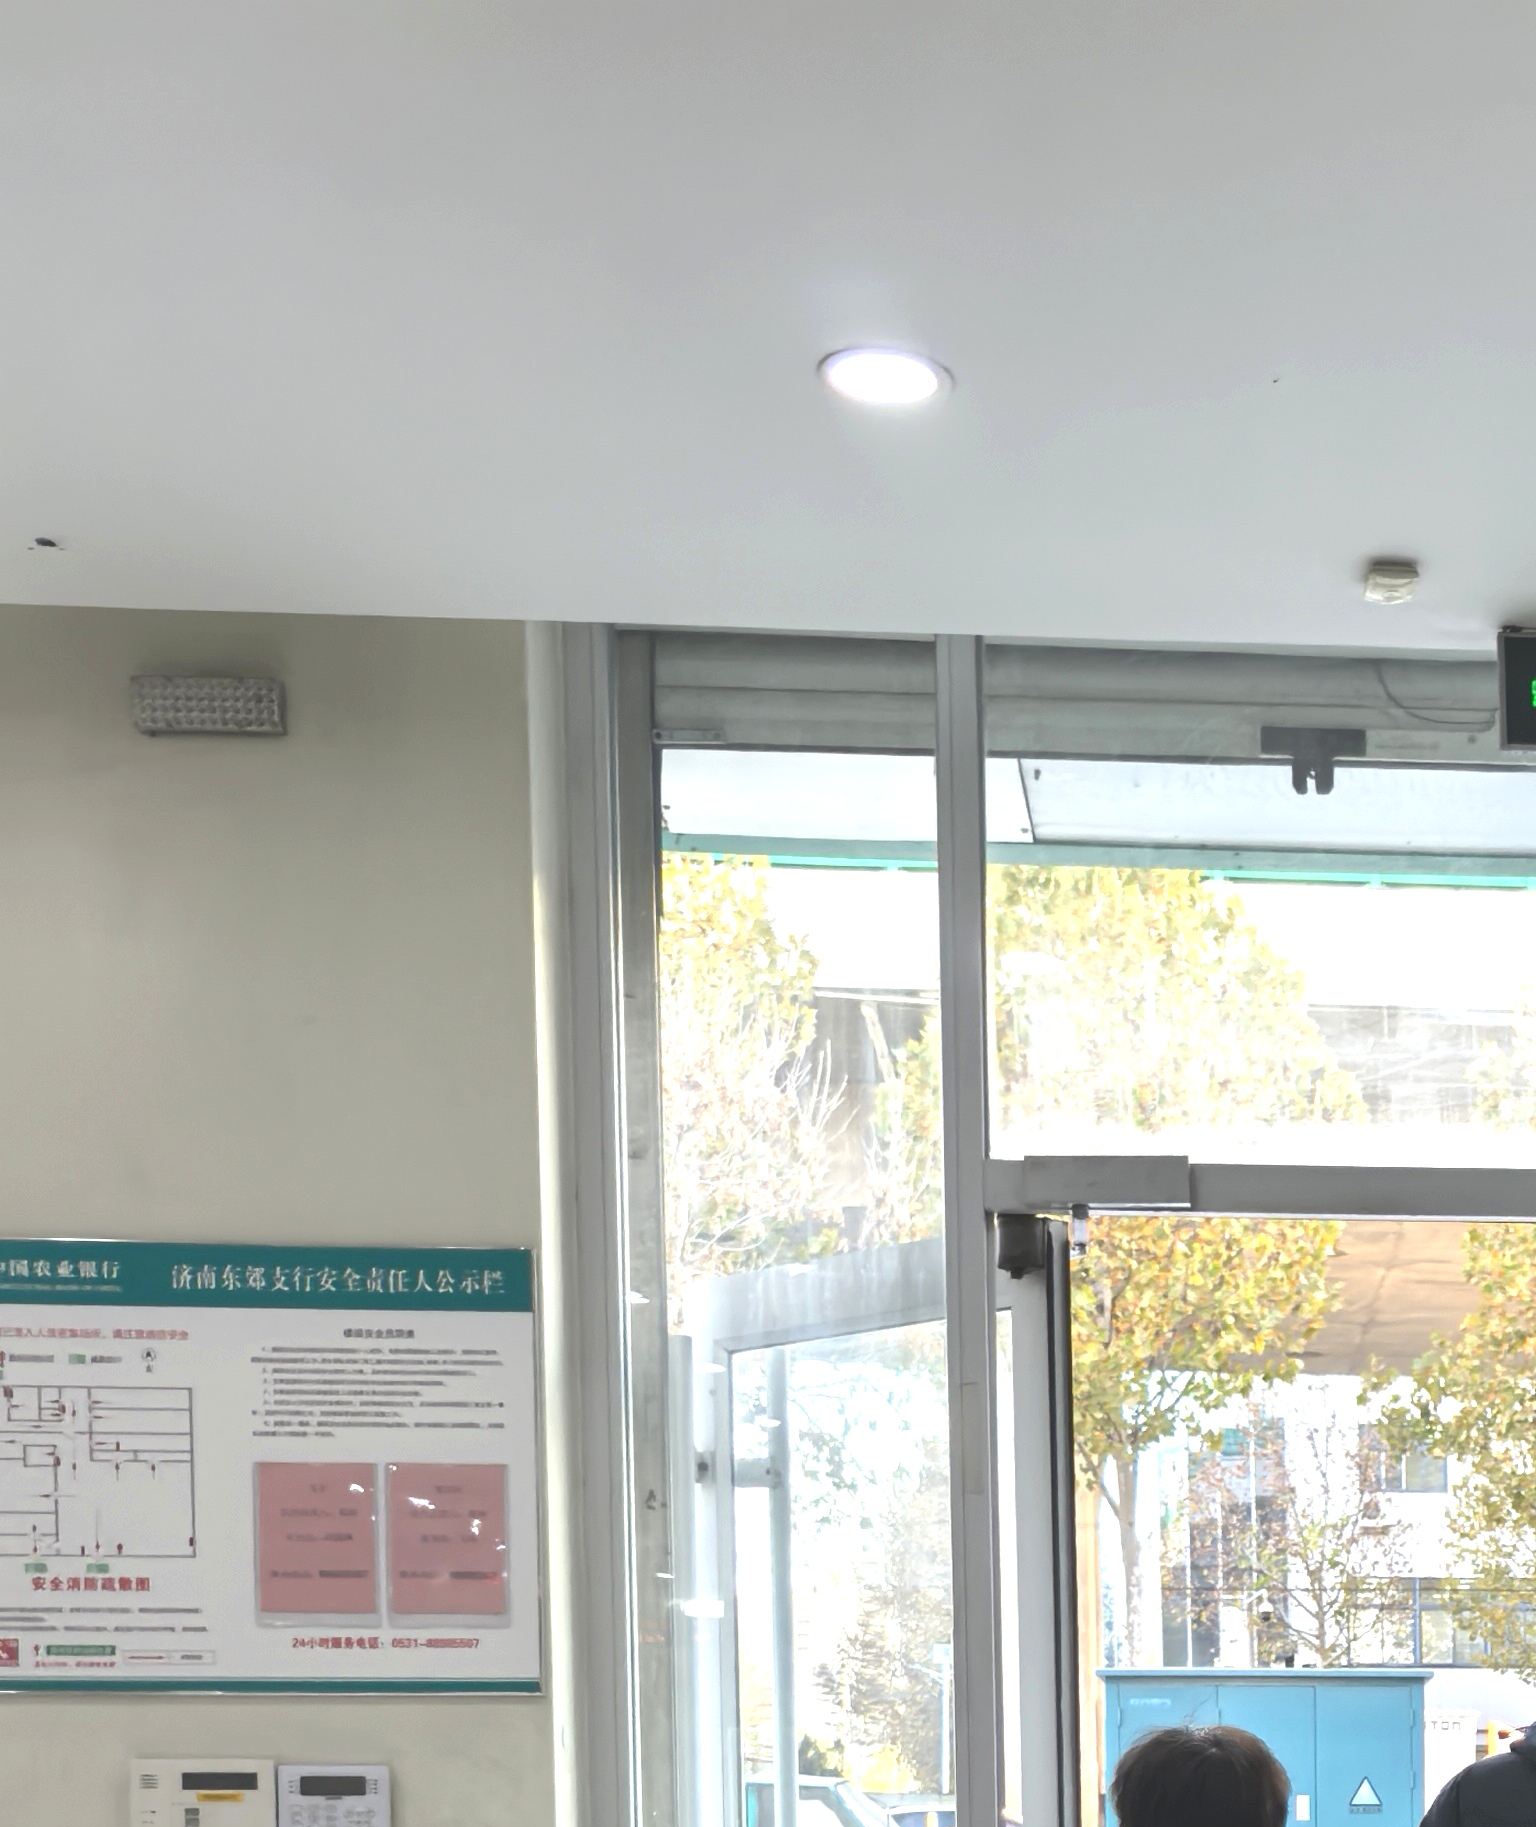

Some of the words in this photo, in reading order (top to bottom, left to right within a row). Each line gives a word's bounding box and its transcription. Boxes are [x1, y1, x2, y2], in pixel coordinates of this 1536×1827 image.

[0, 1259, 120, 1279] 国农业银行
[172, 1263, 505, 1295] 济南东郊支行安全责任人公示栏
